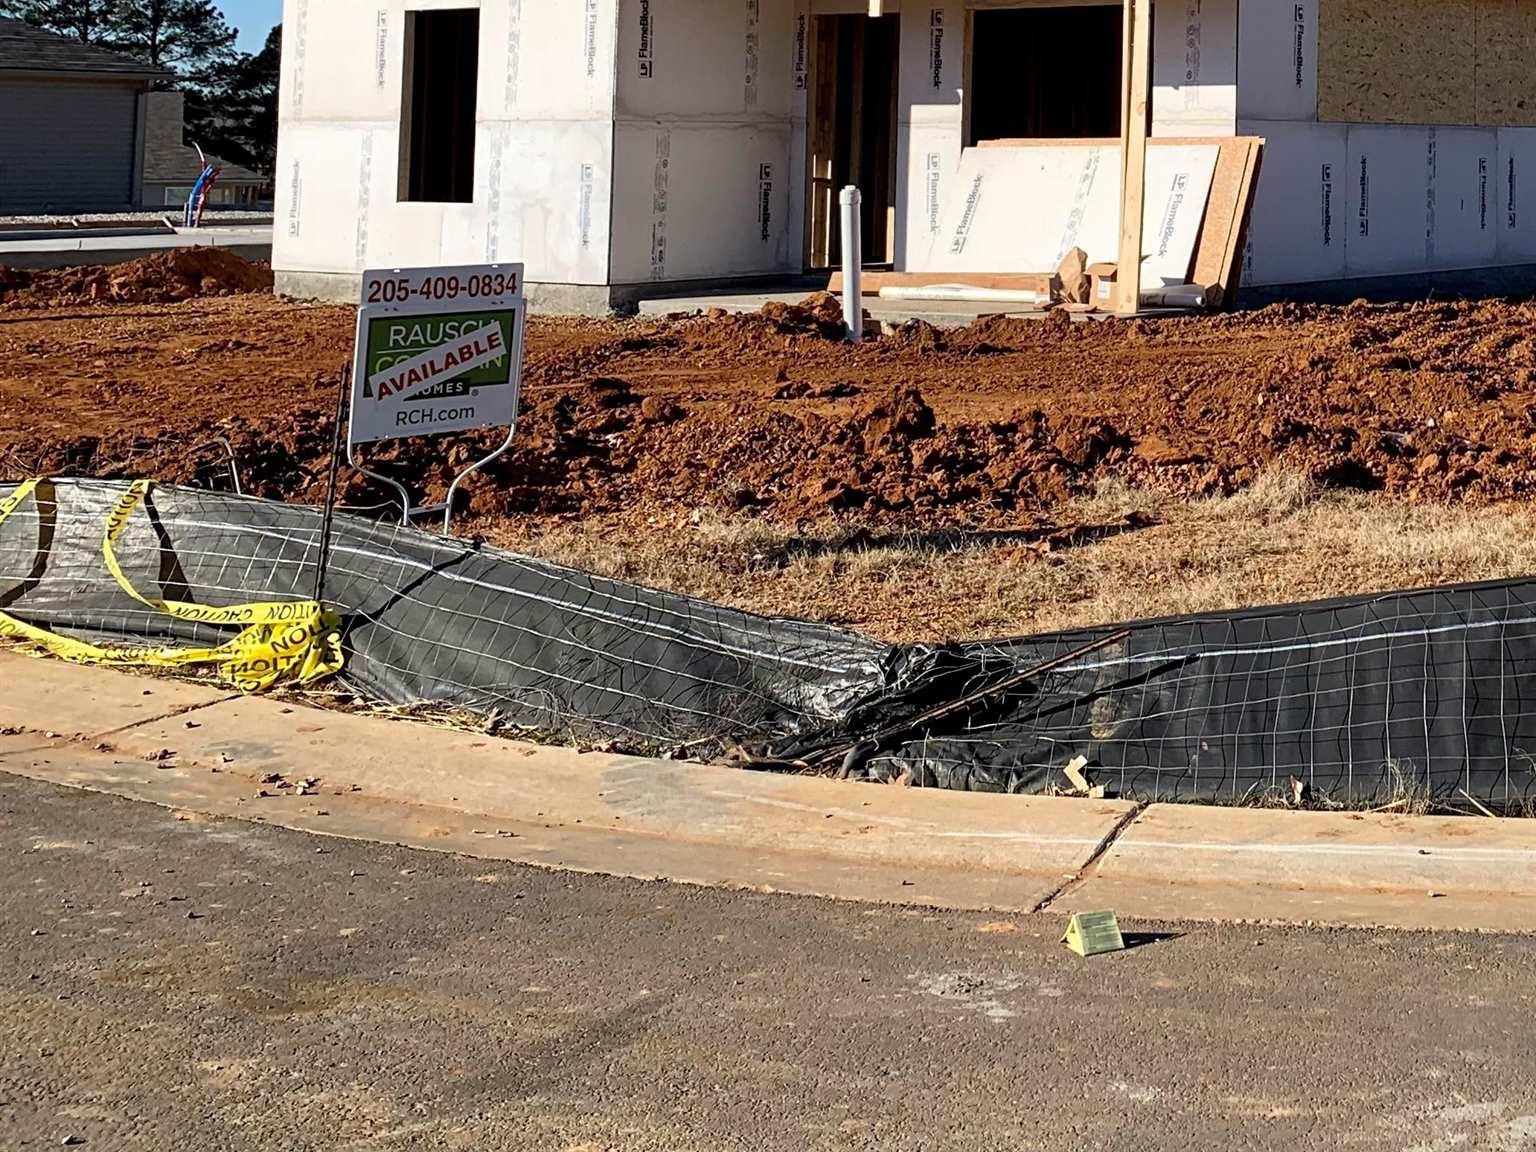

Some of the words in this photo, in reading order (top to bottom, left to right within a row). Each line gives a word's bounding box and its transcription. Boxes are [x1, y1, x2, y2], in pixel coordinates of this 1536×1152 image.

[367, 272, 518, 304] 205-409-0834
[388, 319, 496, 347] RAUSC
[377, 331, 502, 401] AVAILABLE
[395, 406, 475, 427] RCH.com
